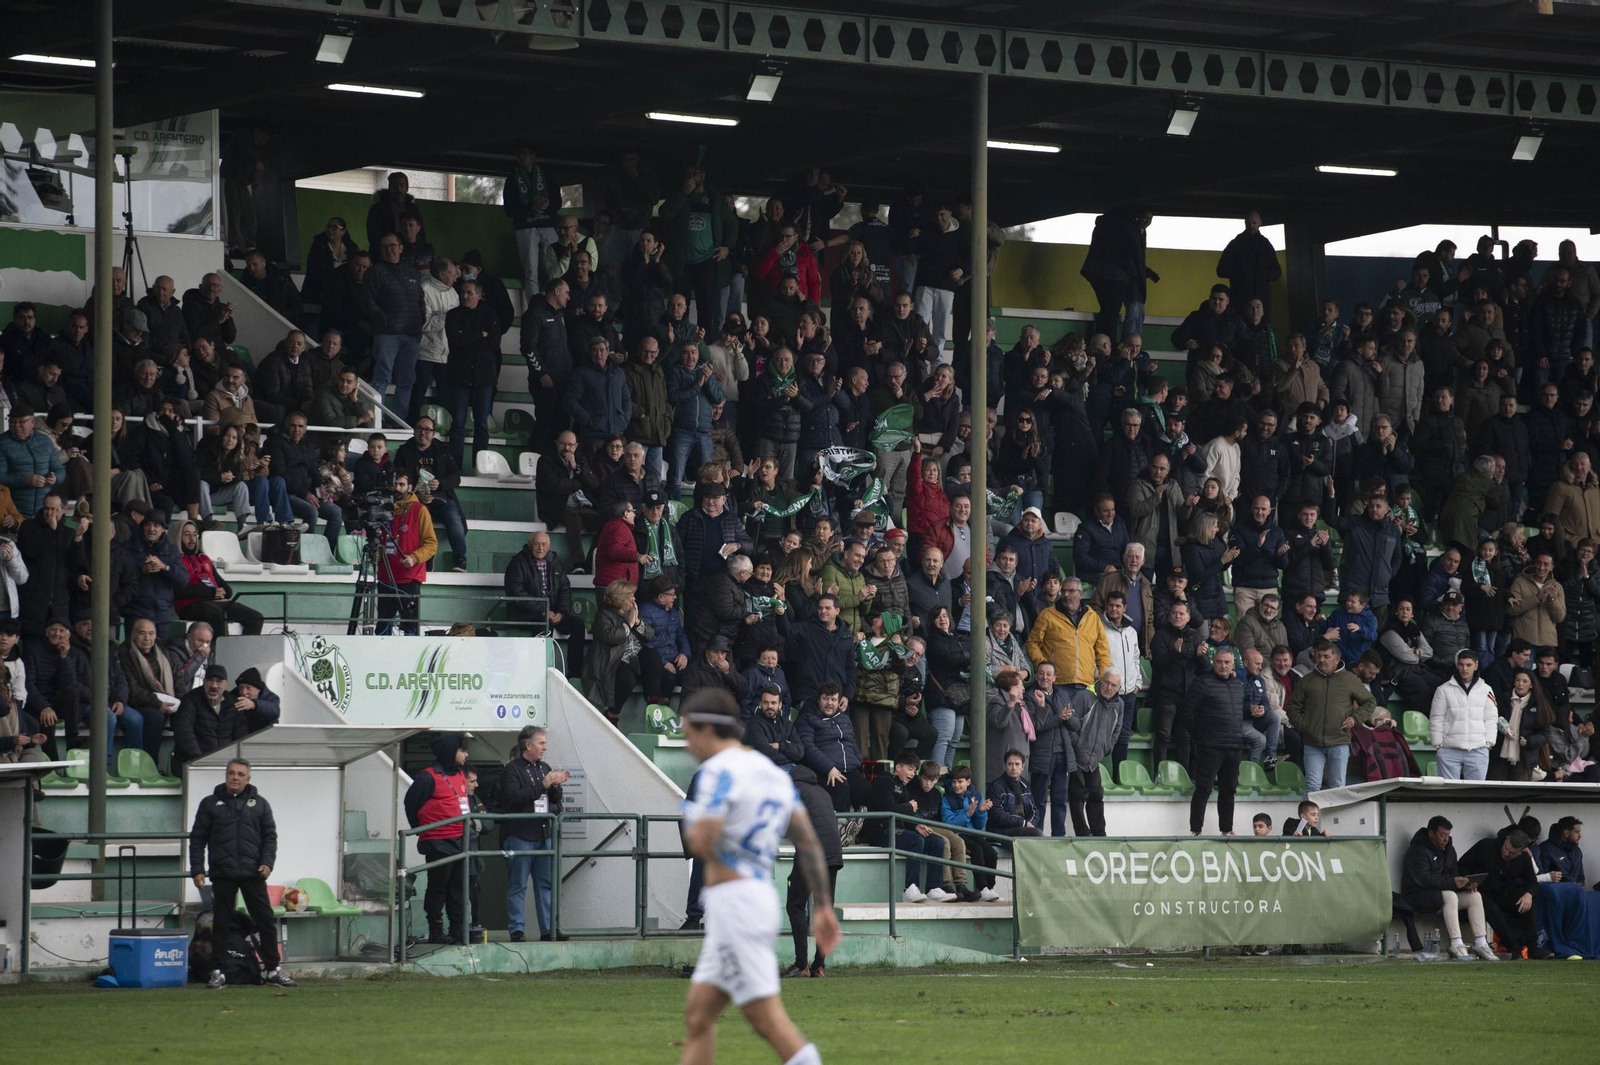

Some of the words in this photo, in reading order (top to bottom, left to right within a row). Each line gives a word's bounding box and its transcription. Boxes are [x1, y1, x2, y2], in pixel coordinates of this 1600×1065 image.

[153, 132, 205, 145] ARENTEIRO
[365, 672, 393, 690] C.D.
[396, 673, 484, 690] ARENTEIRO
[490, 692, 541, 700] www.cdarenteiro.es
[1084, 850, 1195, 884] ORECO
[1202, 843, 1326, 883] BALGÓN
[1133, 900, 1282, 915] CONSTRUCTORA
